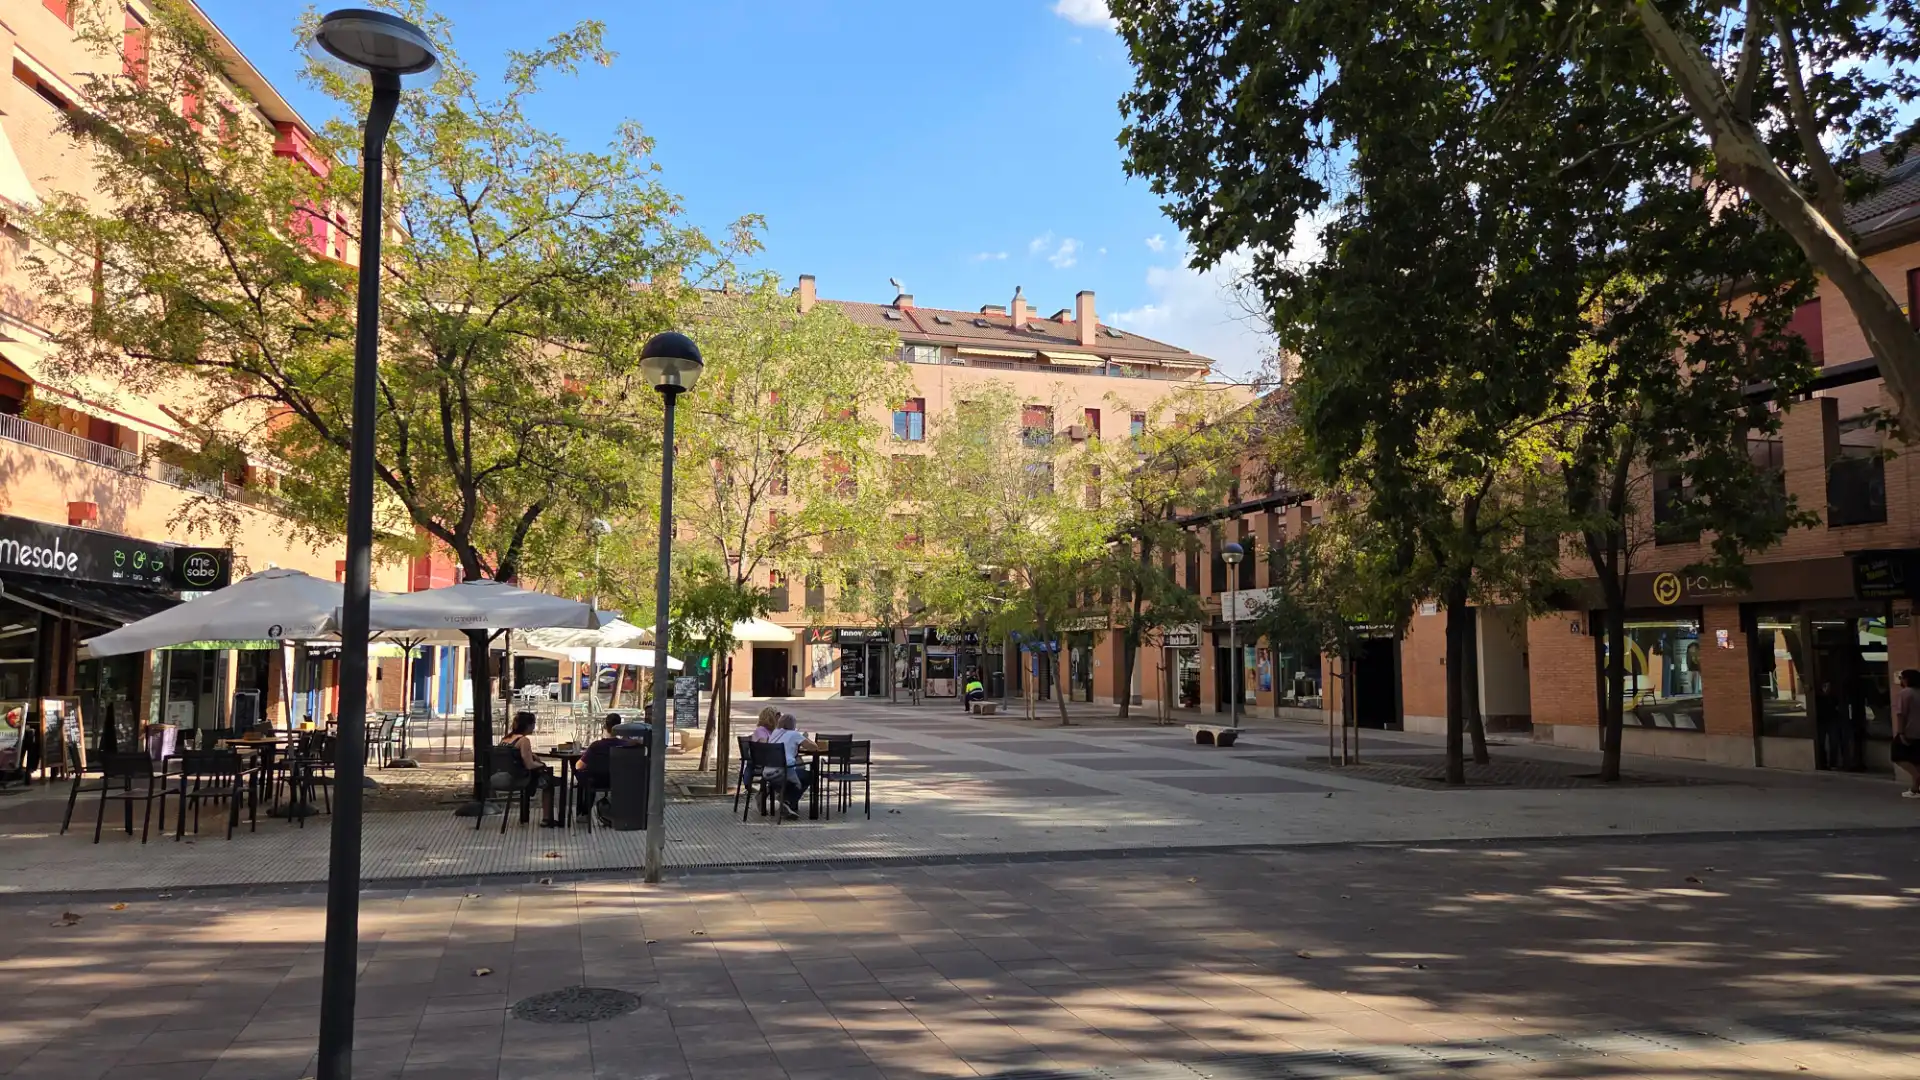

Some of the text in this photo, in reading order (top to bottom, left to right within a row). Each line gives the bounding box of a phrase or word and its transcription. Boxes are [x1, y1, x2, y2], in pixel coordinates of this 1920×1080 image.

[0, 537, 78, 571] mesabe
[190, 557, 210, 567] me
[187, 566, 215, 577] sabe
[444, 615, 489, 624] VICTORIA
